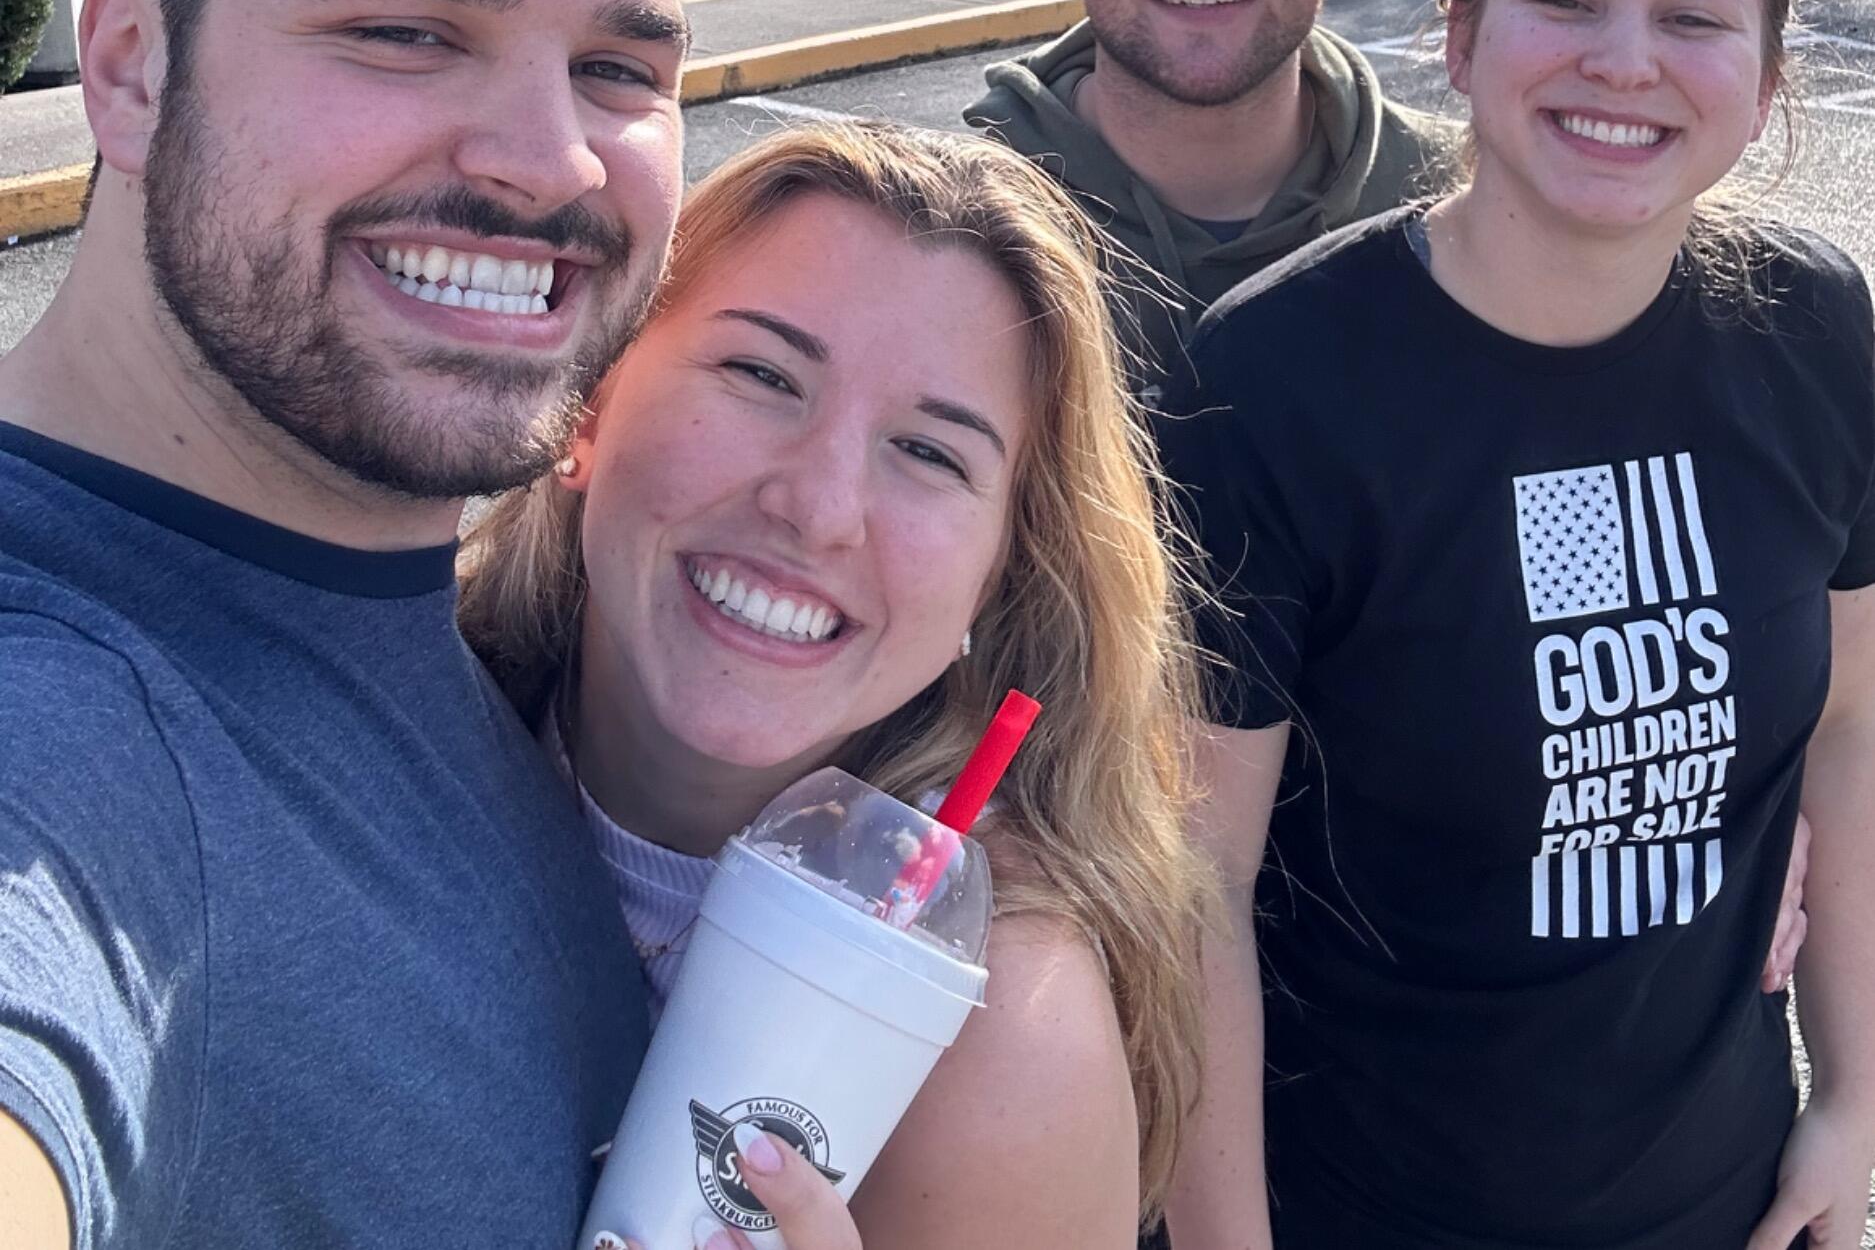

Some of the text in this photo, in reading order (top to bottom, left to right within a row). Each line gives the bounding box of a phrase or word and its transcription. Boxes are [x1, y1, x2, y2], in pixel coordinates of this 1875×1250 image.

[1534, 607, 1730, 726] GOD'S
[1541, 695, 1737, 780] CHILDREN
[1541, 746, 1737, 829] ARE NOT
[1626, 791, 1727, 842] SALE
[746, 1101, 824, 1146] FAMOUS FOR
[700, 1174, 777, 1228] STEAKBURGE
